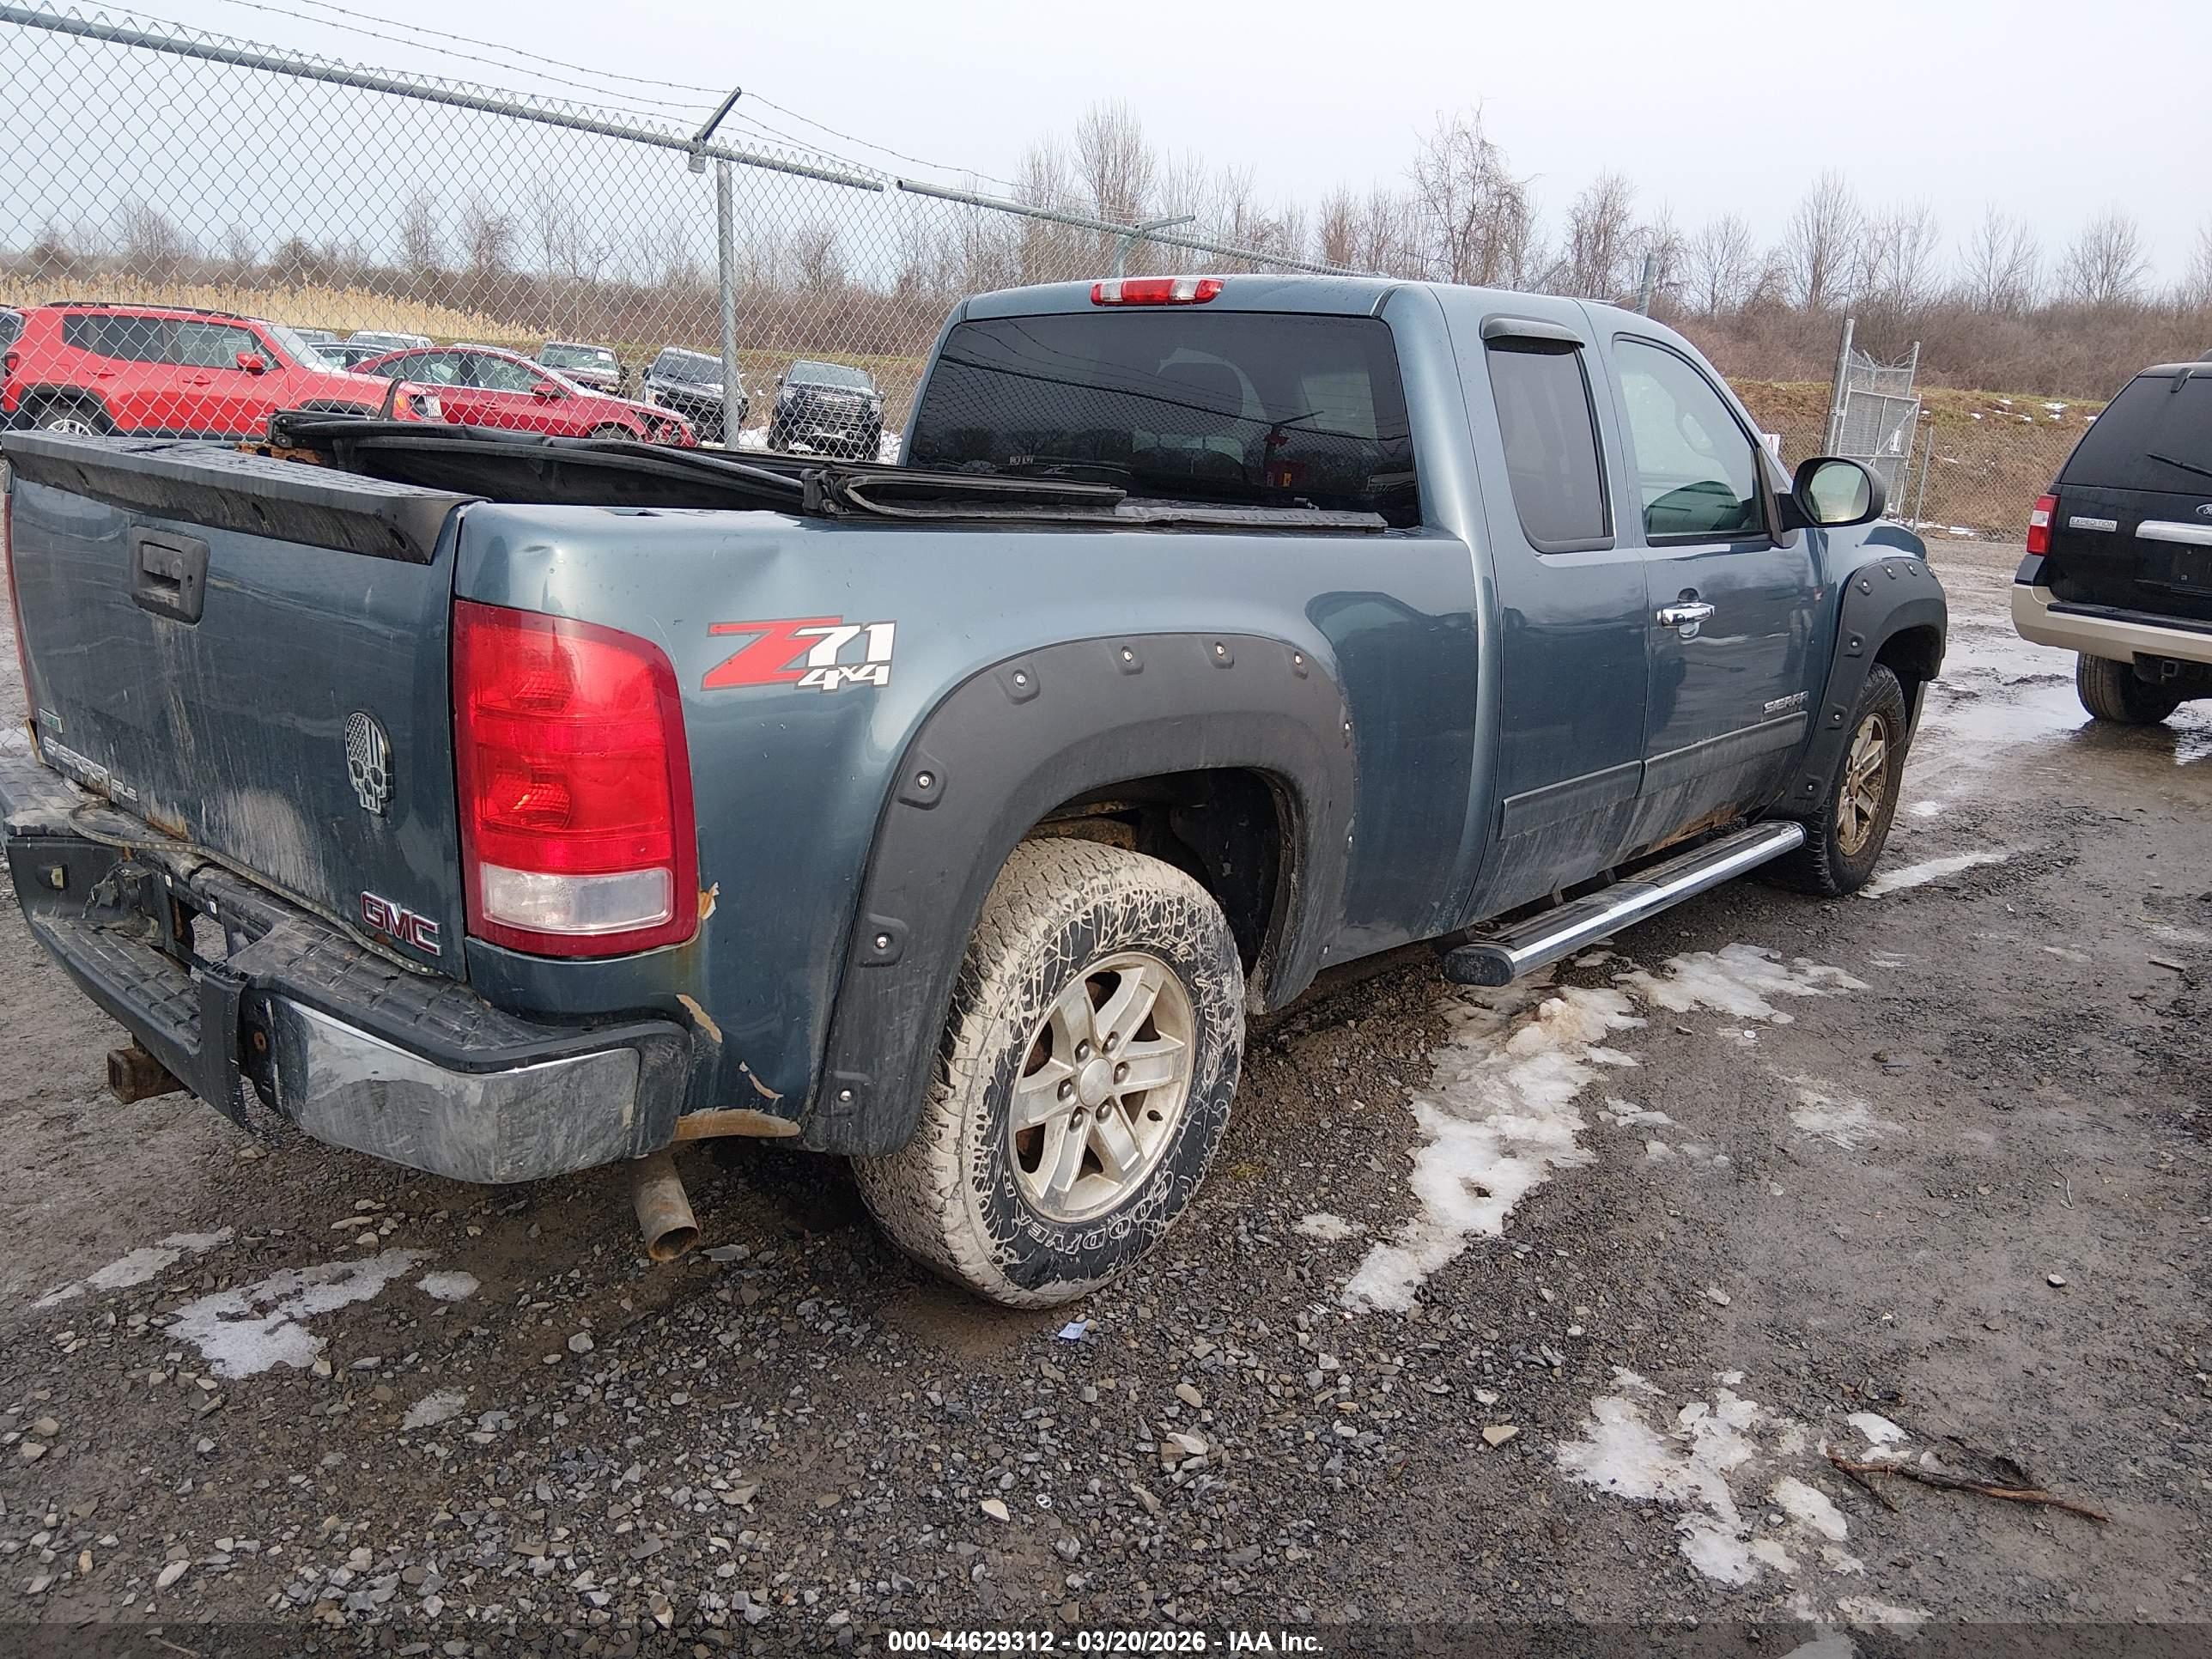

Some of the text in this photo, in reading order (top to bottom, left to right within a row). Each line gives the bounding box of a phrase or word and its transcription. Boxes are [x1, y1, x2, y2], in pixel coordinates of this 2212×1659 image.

[2070, 518, 2116, 528] EXPEDITION
[701, 615, 897, 691] Z71
[1764, 690, 1809, 714] SIERRA
[44, 736, 138, 802] SIERRA SLE
[361, 890, 442, 957] GMC
[1002, 1169, 1176, 1255] GOODYEAR
